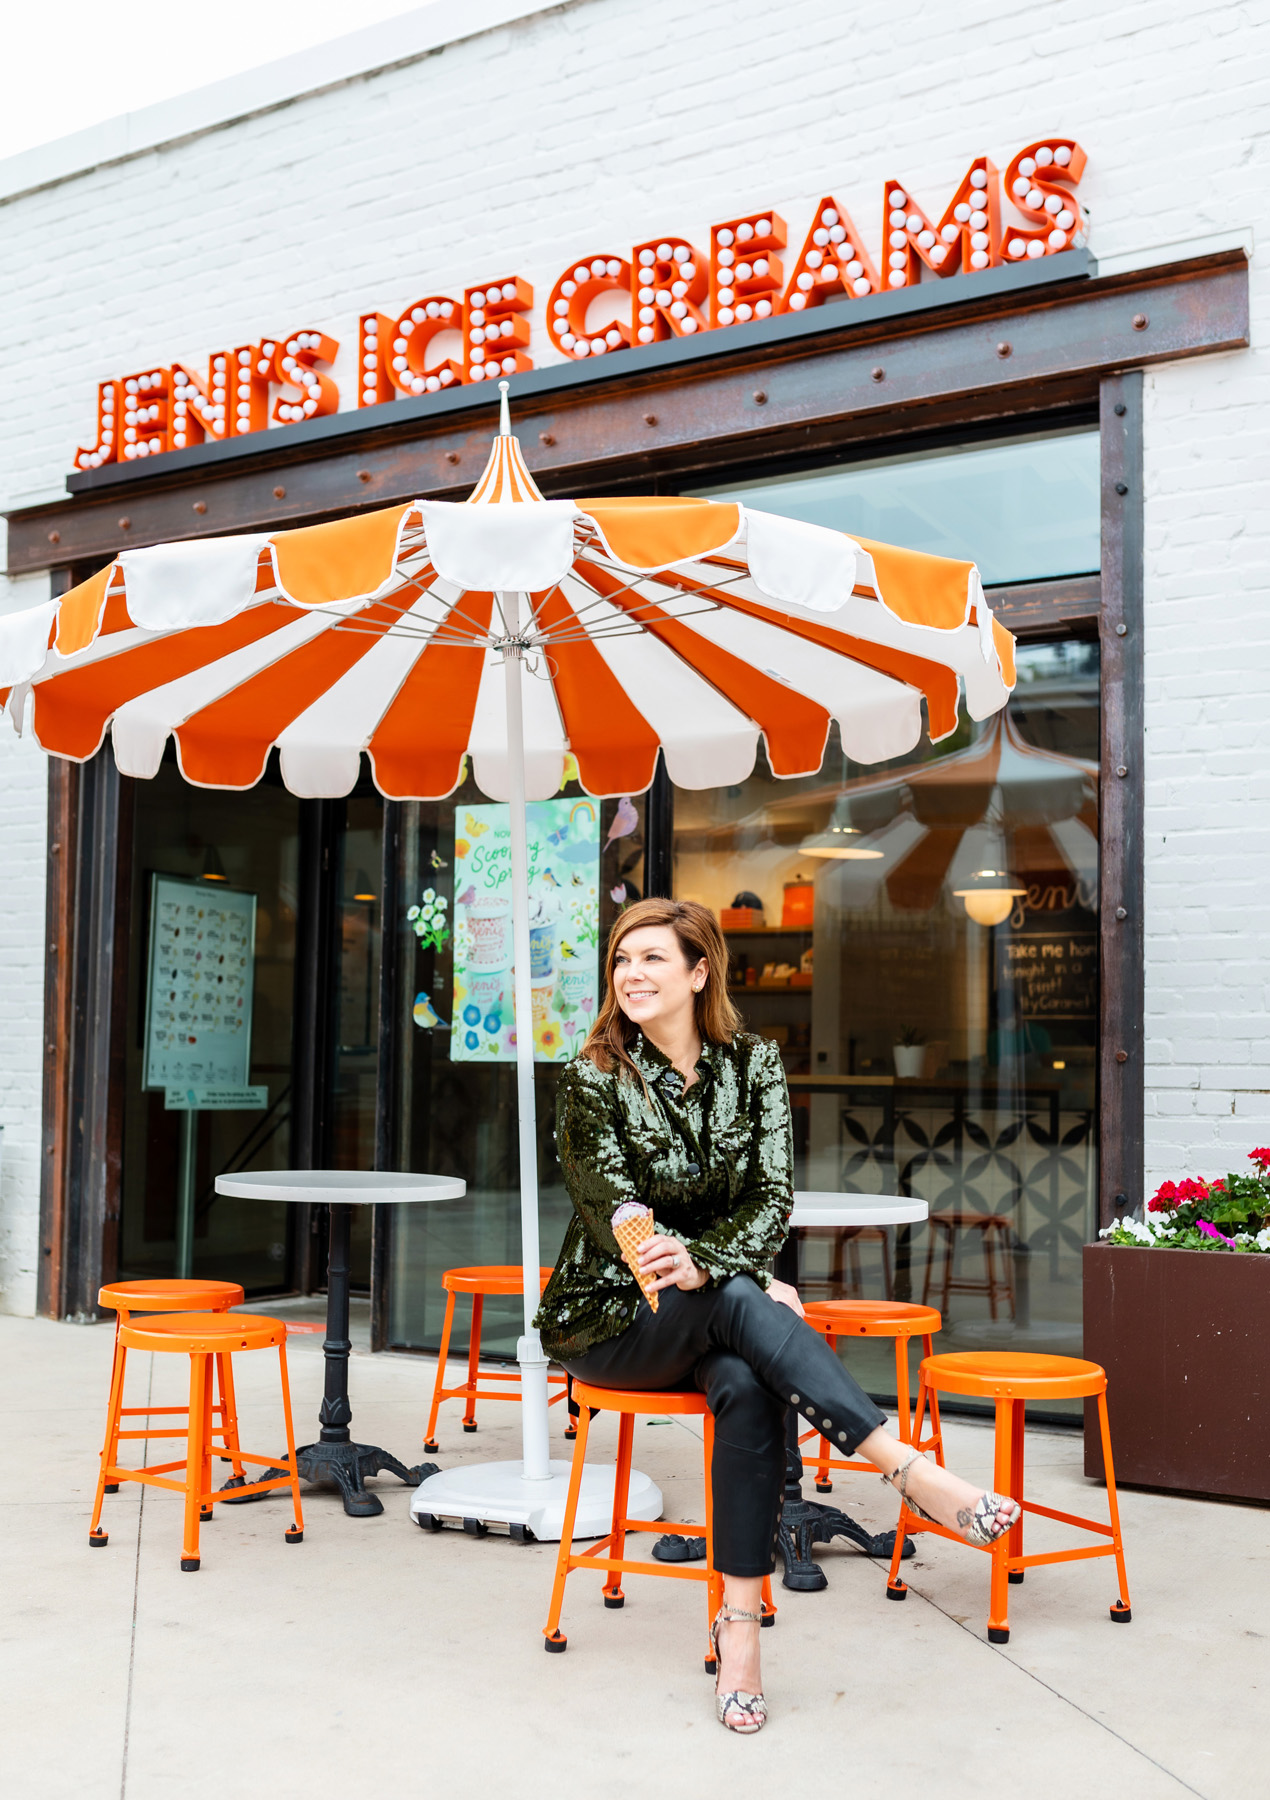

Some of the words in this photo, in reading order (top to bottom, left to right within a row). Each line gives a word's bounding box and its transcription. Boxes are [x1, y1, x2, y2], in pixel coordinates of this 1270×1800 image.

[74, 330, 339, 471] JENI'S
[358, 276, 533, 407] ICE
[547, 138, 1087, 359] CREAMS
